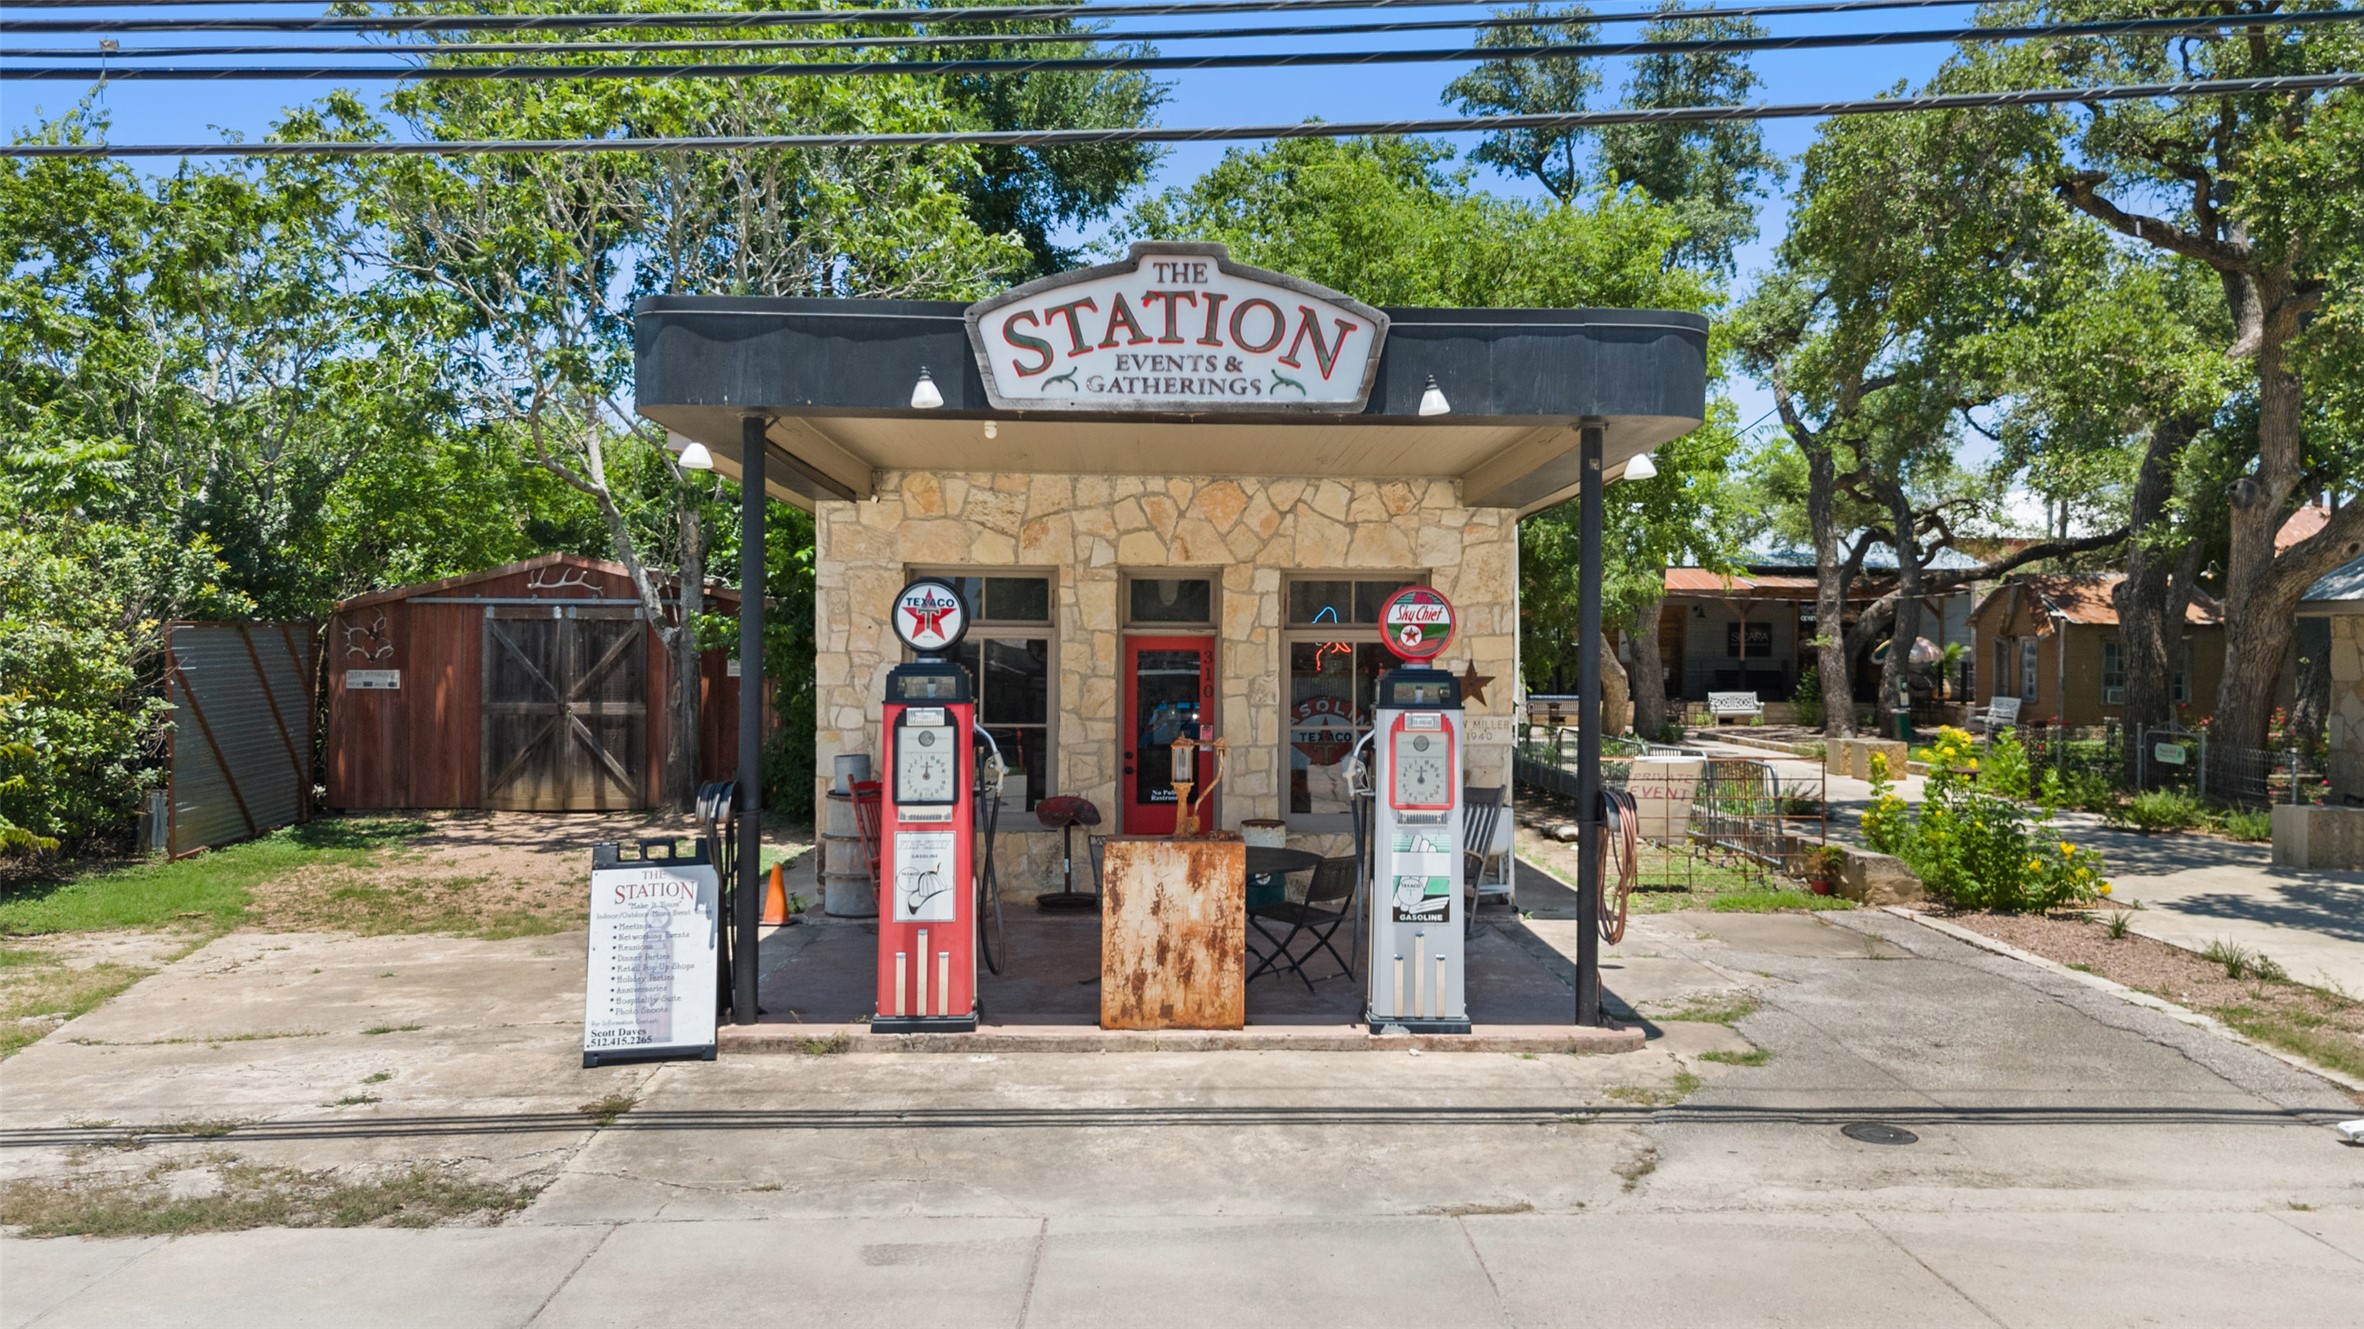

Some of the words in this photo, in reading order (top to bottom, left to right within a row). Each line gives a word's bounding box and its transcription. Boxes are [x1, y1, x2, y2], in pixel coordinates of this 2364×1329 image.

[1153, 262, 1208, 284] THE
[1002, 290, 1357, 380] STATION
[1115, 354, 1218, 373] EVENTS
[1225, 356, 1243, 373] &
[1086, 375, 1262, 396] GATHERINGS
[906, 597, 955, 608] TEXACO
[1396, 604, 1416, 623] Sky
[1416, 605, 1444, 622] Chief
[1473, 720, 1510, 730] MILLER
[1299, 732, 1352, 742] TEXACO
[1467, 732, 1493, 741] 1940
[1629, 785, 1690, 801] EVENT
[642, 871, 665, 880] THE
[615, 881, 695, 905] STATION
[619, 922, 652, 932] Meetings
[615, 1008, 639, 1016] Photo
[591, 1029, 615, 1038] Scott
[619, 1028, 647, 1036] Daves
[590, 1036, 653, 1048] 512.415.2265
